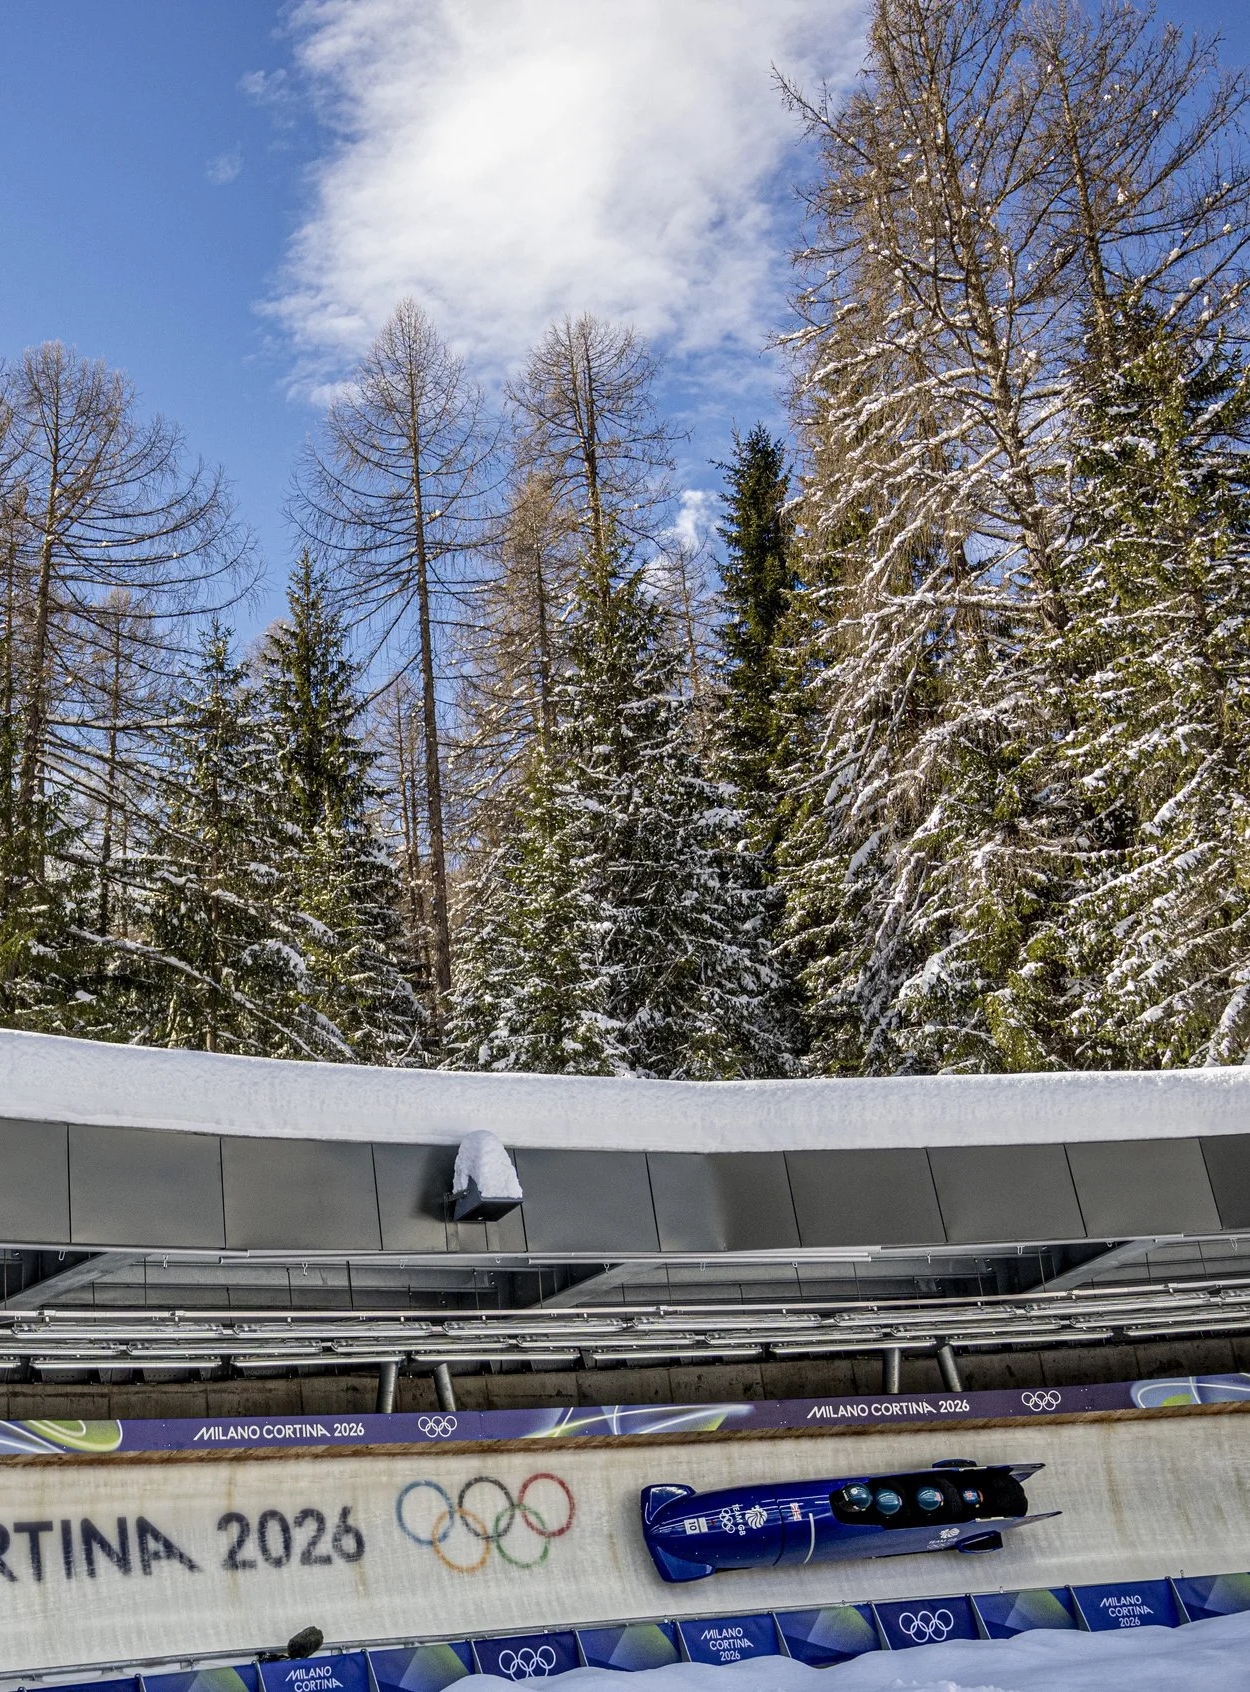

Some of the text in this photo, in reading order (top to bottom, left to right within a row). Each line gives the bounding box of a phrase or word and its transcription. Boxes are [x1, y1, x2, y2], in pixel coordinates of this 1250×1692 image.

[806, 1399, 970, 1419] MILANO CORTINA 2026
[193, 1422, 365, 1441] MILANO CORTINA 2026
[688, 1521, 697, 1531] 10
[732, 1504, 746, 1536] TEAM GB
[216, 1505, 366, 1570] 2026
[1100, 1595, 1142, 1607] MILANO
[1108, 1605, 1154, 1617] CORTINA
[1118, 1616, 1141, 1627] 2026
[701, 1627, 743, 1640] MILANO
[710, 1638, 754, 1650] CORTINA
[719, 1650, 741, 1661] 2026
[285, 1666, 332, 1682] MILANO
[294, 1677, 344, 1692] CORTINA
